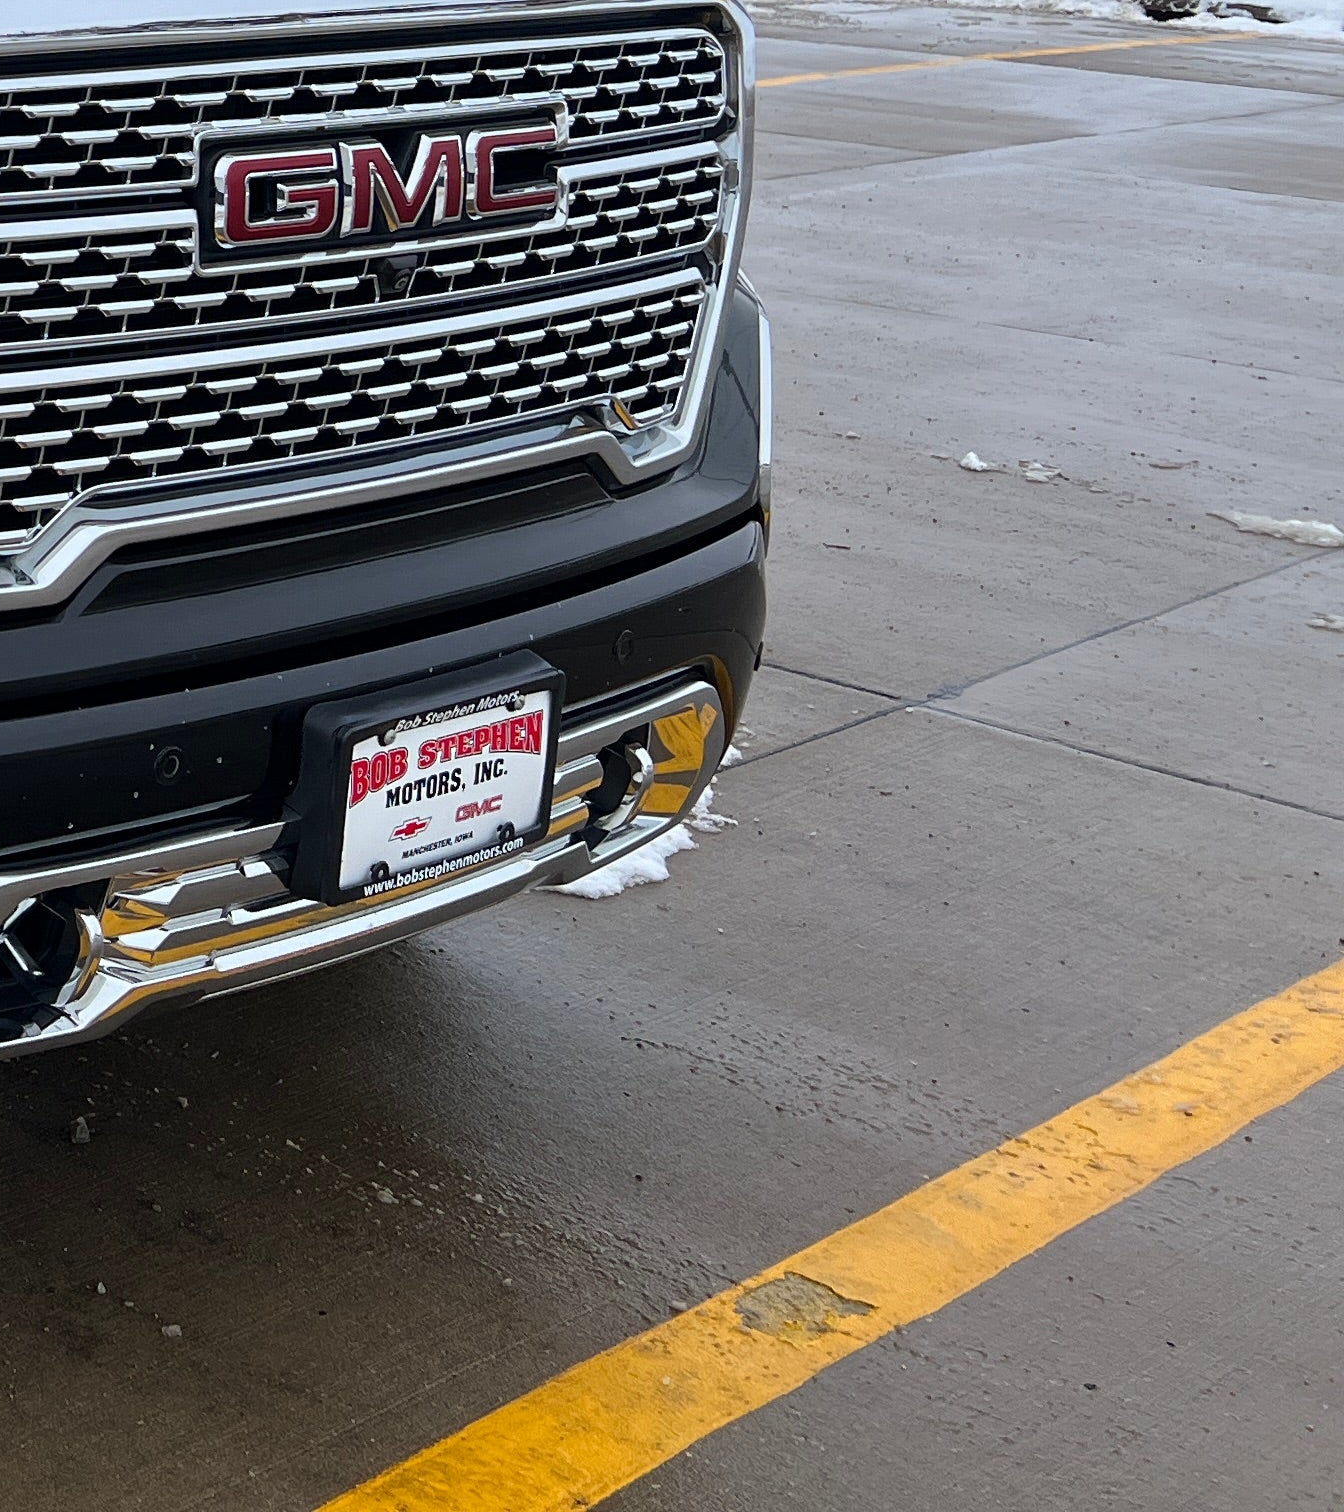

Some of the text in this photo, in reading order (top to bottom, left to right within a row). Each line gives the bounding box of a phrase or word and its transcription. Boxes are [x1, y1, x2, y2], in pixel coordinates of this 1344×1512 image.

[214, 122, 557, 249] GMC
[395, 690, 520, 732] Bob Stephen Motors
[349, 709, 544, 809] BOB STEPHEN
[385, 757, 508, 809] MOTORS, INC.
[454, 793, 503, 823] GMC
[454, 830, 474, 844] IOWA
[363, 835, 524, 897] www.bobstephenmotors.com
